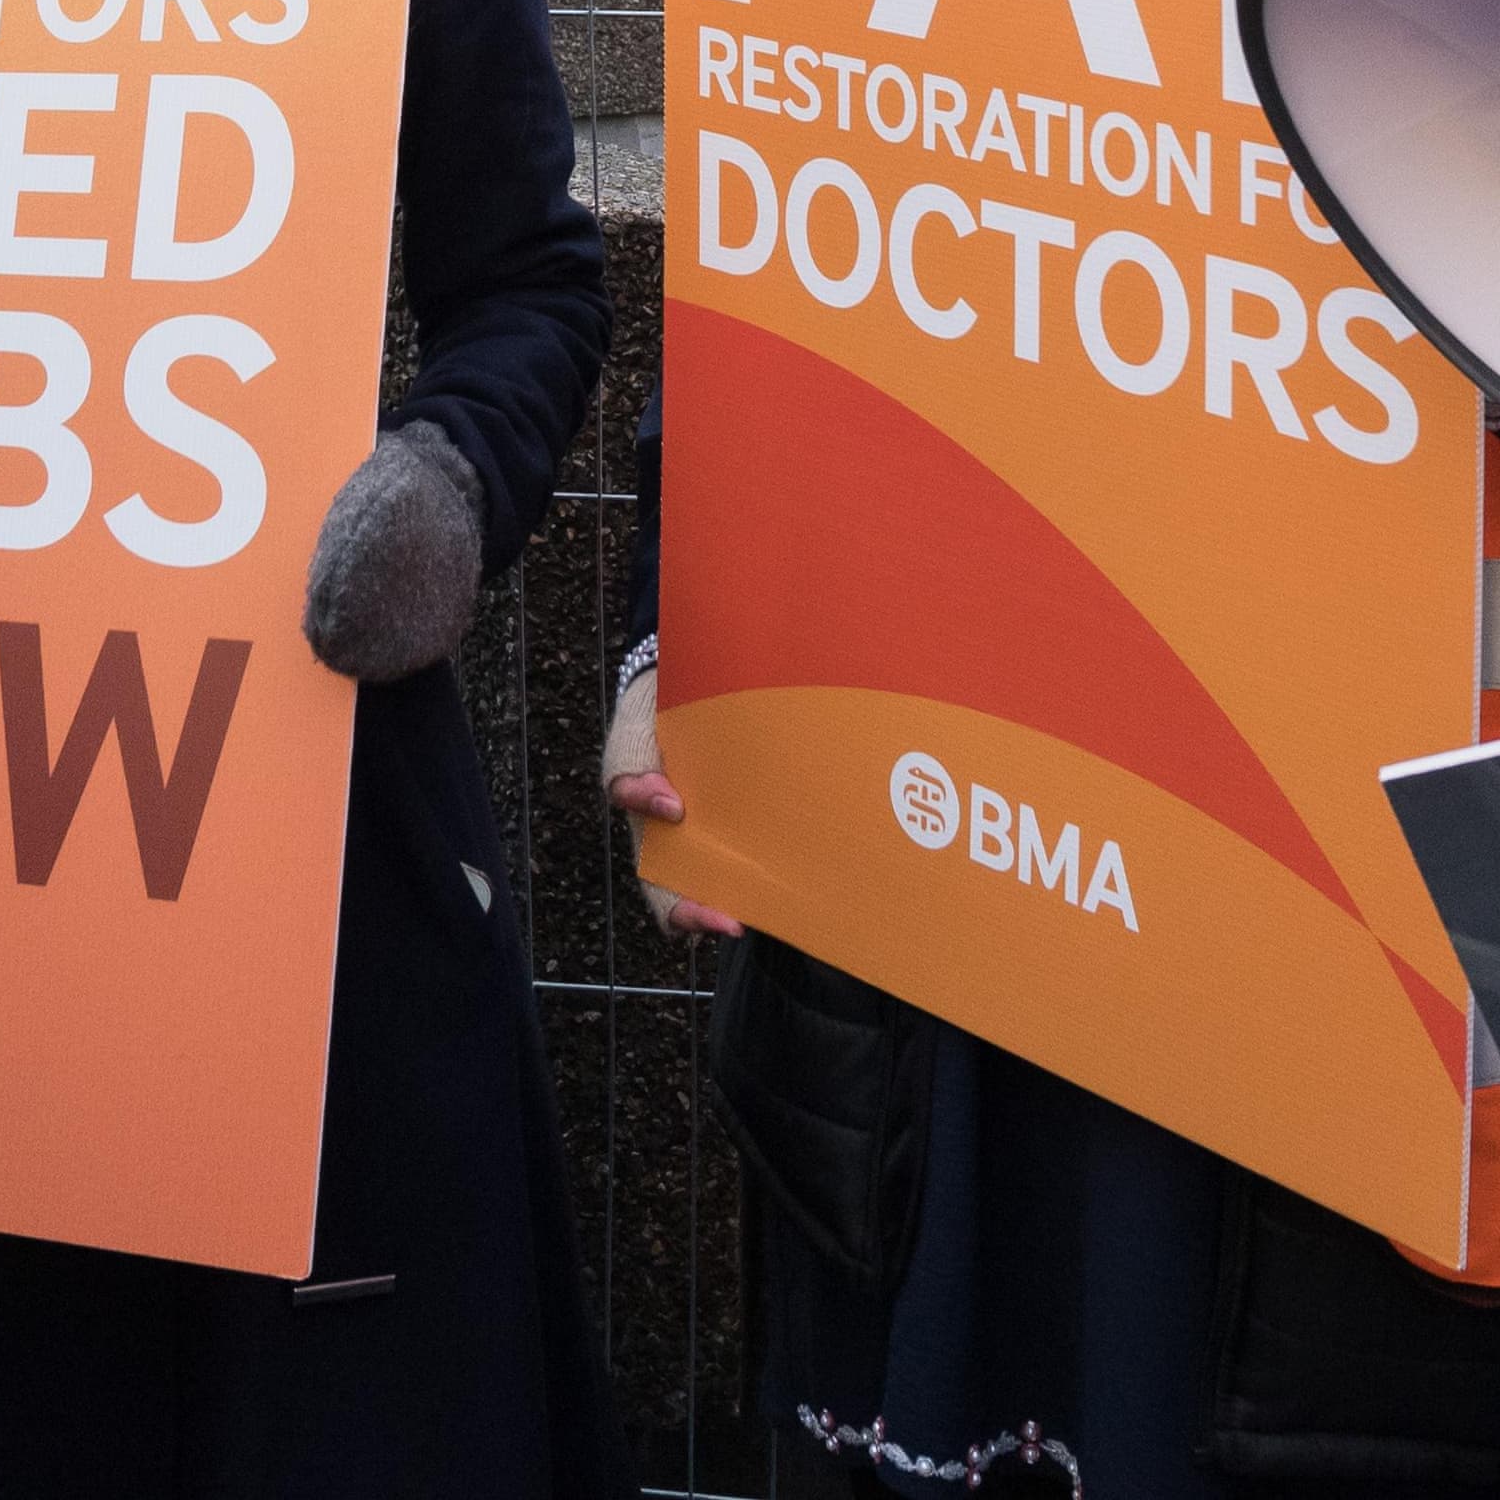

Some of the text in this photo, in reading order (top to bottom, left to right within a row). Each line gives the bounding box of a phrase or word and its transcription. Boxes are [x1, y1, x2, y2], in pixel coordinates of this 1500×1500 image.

[698, 25, 1213, 217] RESTORATION
[698, 130, 1419, 465] DOCTORS
[968, 782, 1140, 933] BMA
